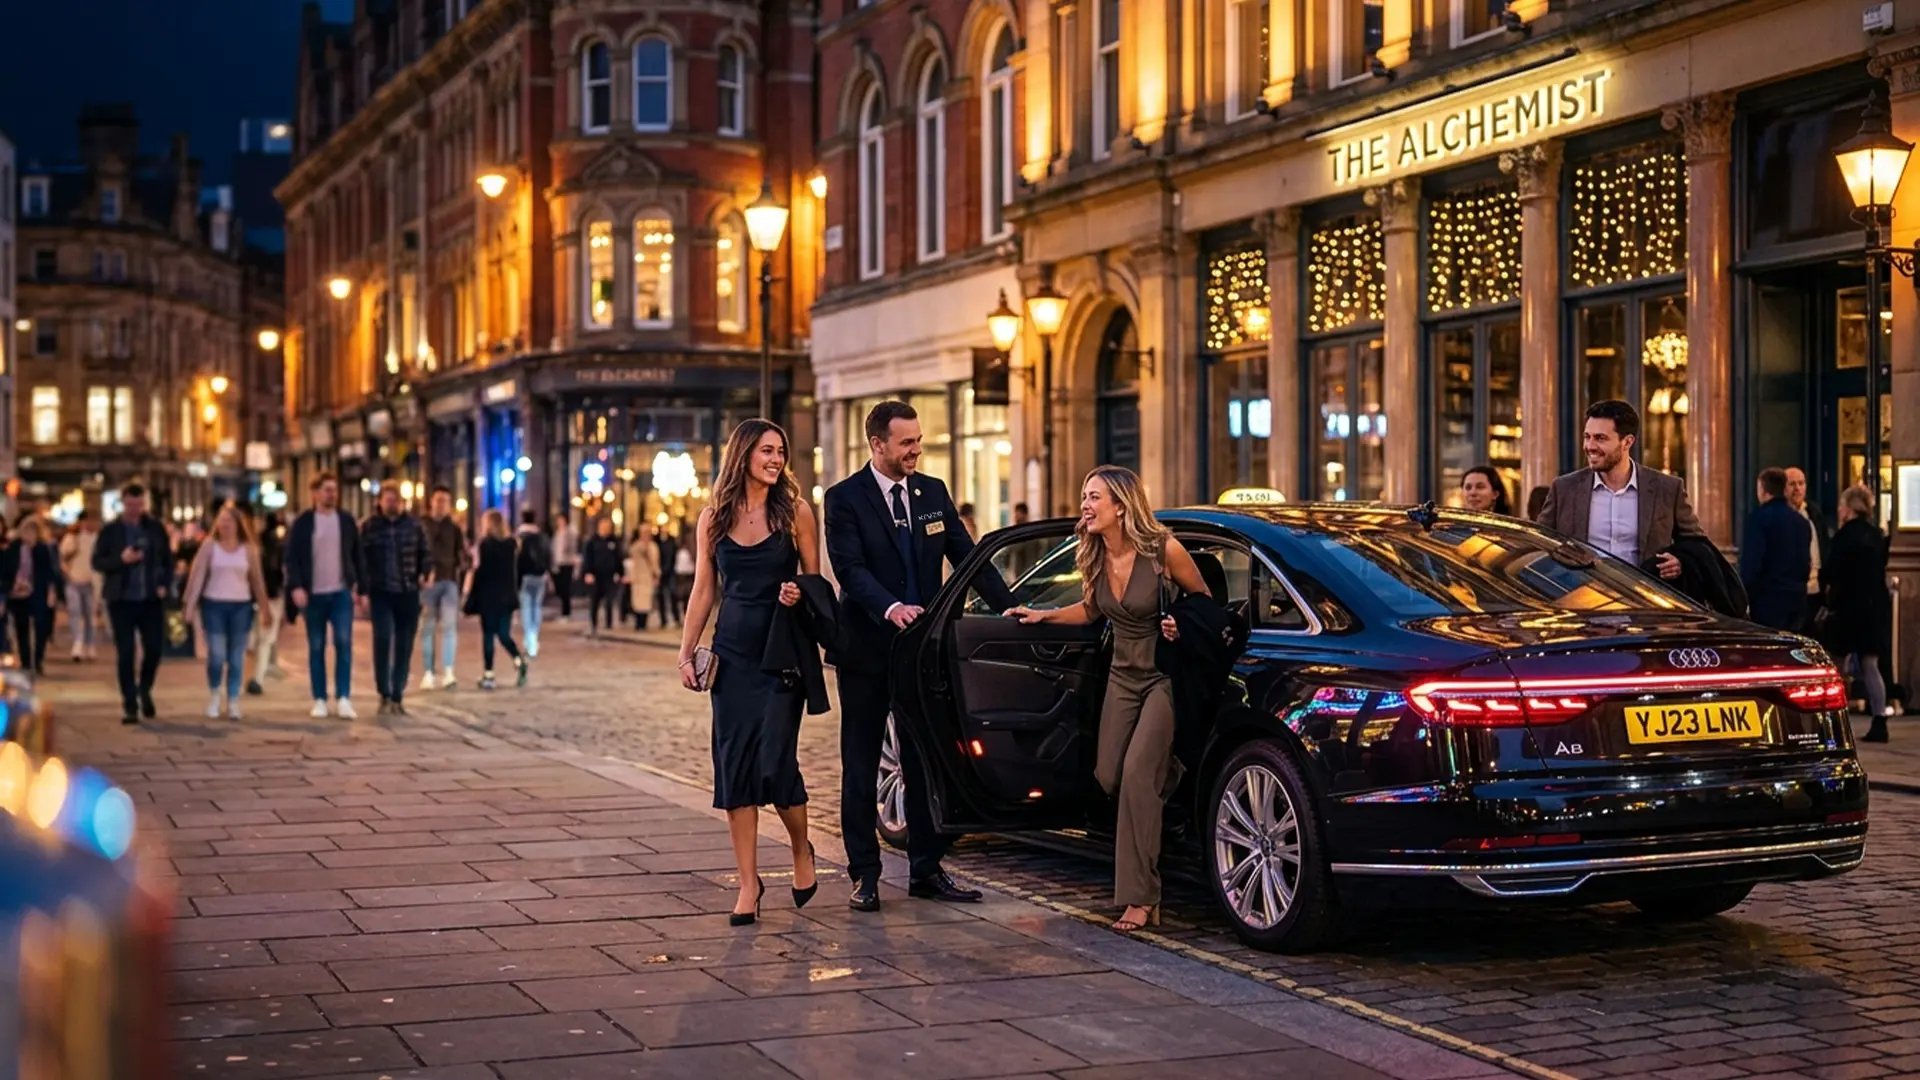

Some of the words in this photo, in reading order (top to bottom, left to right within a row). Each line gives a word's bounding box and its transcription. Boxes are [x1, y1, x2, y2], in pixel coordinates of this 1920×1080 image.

[1328, 135, 1386, 182] THE
[1398, 70, 1608, 165] ALCHEMIST
[1635, 709, 1700, 738] YJ23
[1706, 706, 1752, 733] LNK
